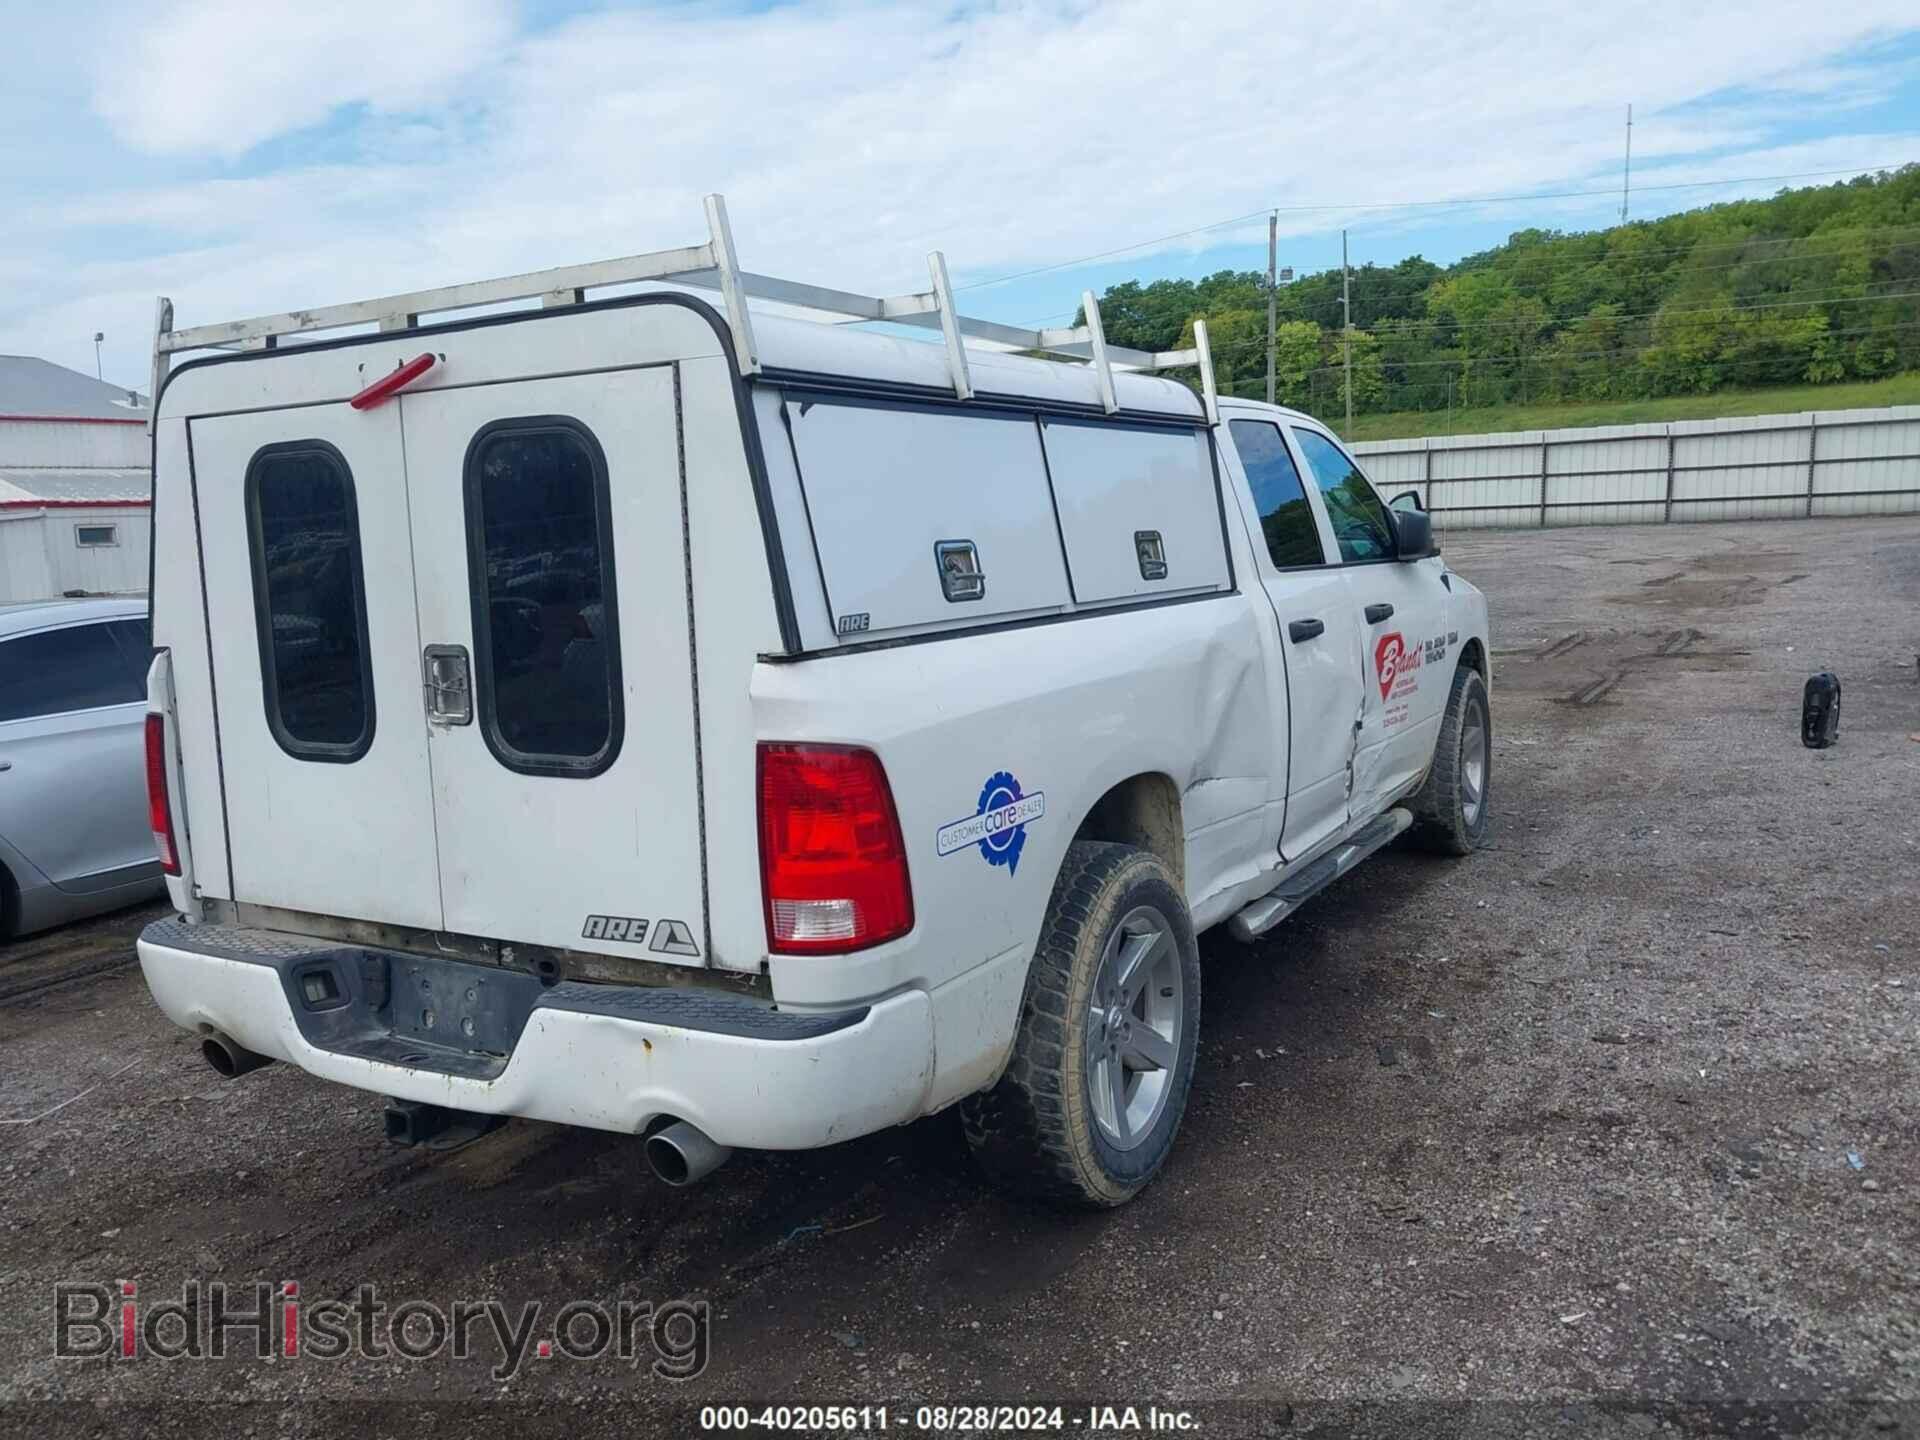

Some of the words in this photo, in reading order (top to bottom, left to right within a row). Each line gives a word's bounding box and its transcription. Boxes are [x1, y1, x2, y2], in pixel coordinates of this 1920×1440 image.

[839, 612, 870, 633] ARE
[940, 820, 984, 847] CUSTOMER
[984, 805, 1017, 833] care
[1017, 799, 1042, 818] DEALER
[581, 914, 650, 943] ARE
